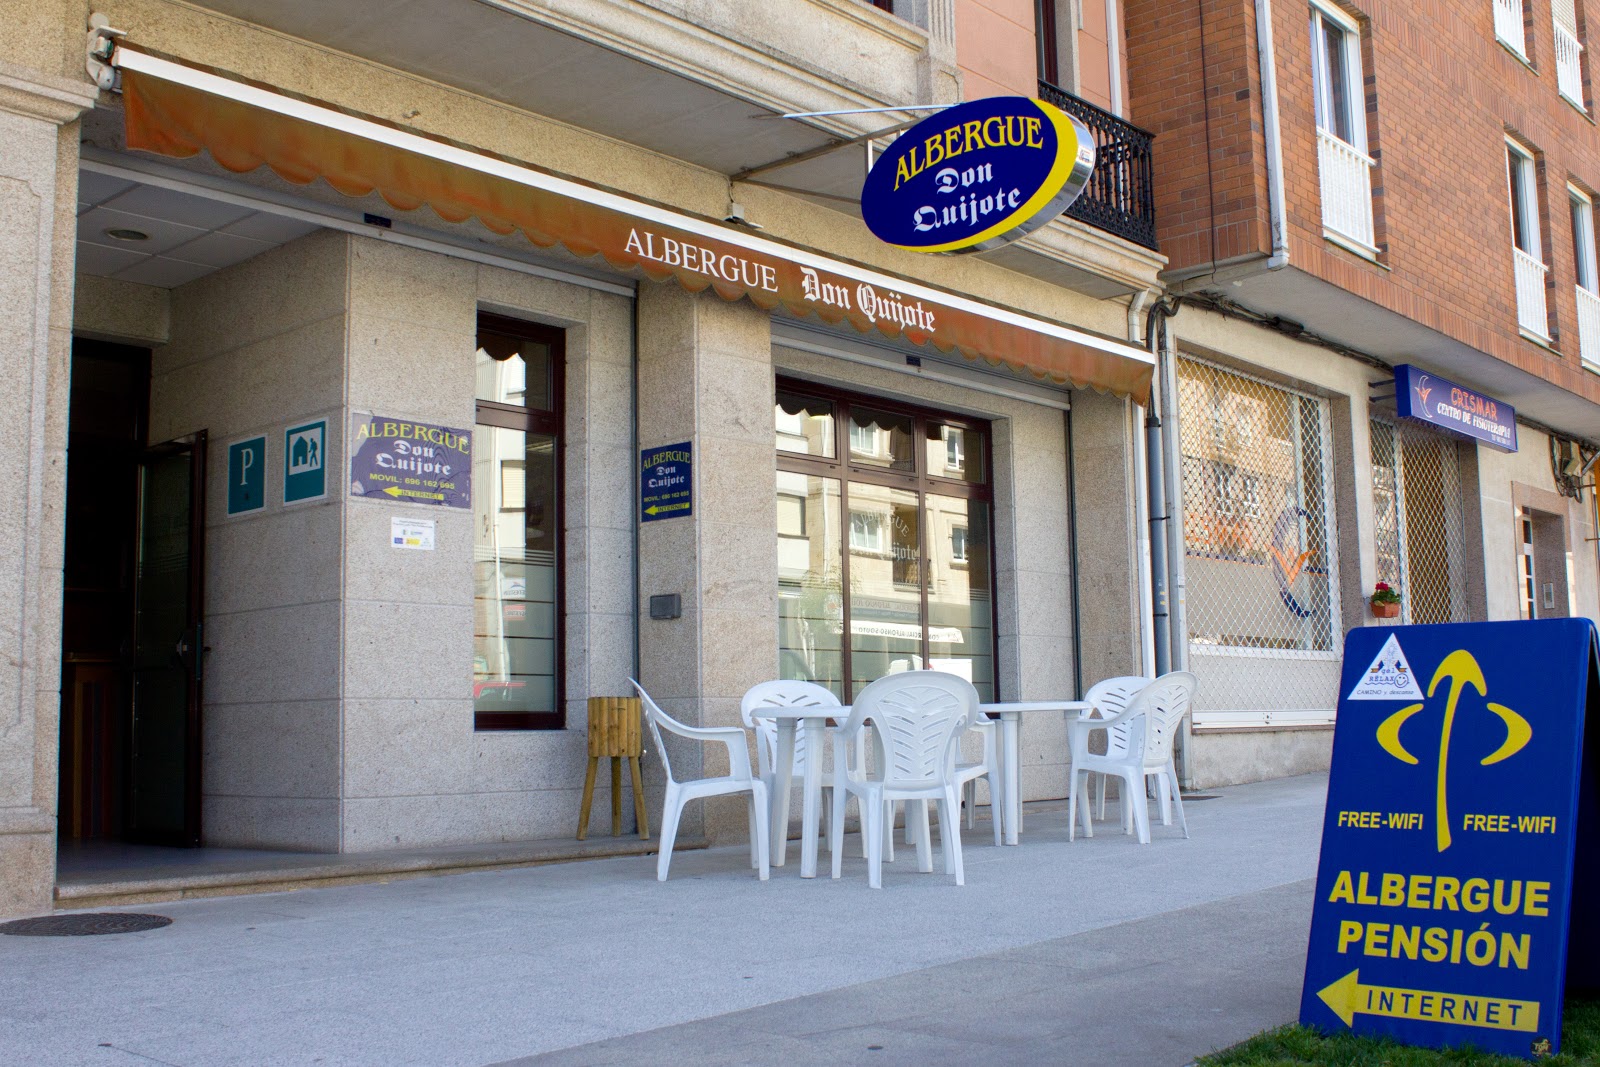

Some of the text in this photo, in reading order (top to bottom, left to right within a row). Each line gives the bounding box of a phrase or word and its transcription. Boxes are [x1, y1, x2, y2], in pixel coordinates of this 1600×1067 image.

[893, 115, 1044, 191] ALBERGUE
[935, 162, 994, 195] Don
[913, 187, 1021, 232] Quijote
[624, 227, 936, 333] ALBERGUE Don Quijote
[1437, 402, 1511, 439] CENTRO DE FISIOTERAPIA
[1450, 387, 1498, 421] CRISMAR
[356, 422, 470, 454] ALBERGUE
[393, 439, 434, 458] Don
[240, 448, 254, 486] P
[376, 452, 452, 476] Quijote
[643, 450, 691, 471] ALBERGUE
[656, 466, 676, 476] Don
[648, 475, 685, 488] Quijote
[658, 503, 687, 512] INTERNET
[1338, 811, 1423, 830] FREE-WIFI
[1463, 813, 1556, 834] FREE-WIFI
[1328, 870, 1550, 917] ALBERGUE
[1337, 920, 1531, 970] PENSIÓN
[1367, 989, 1522, 1026] INTERNET
